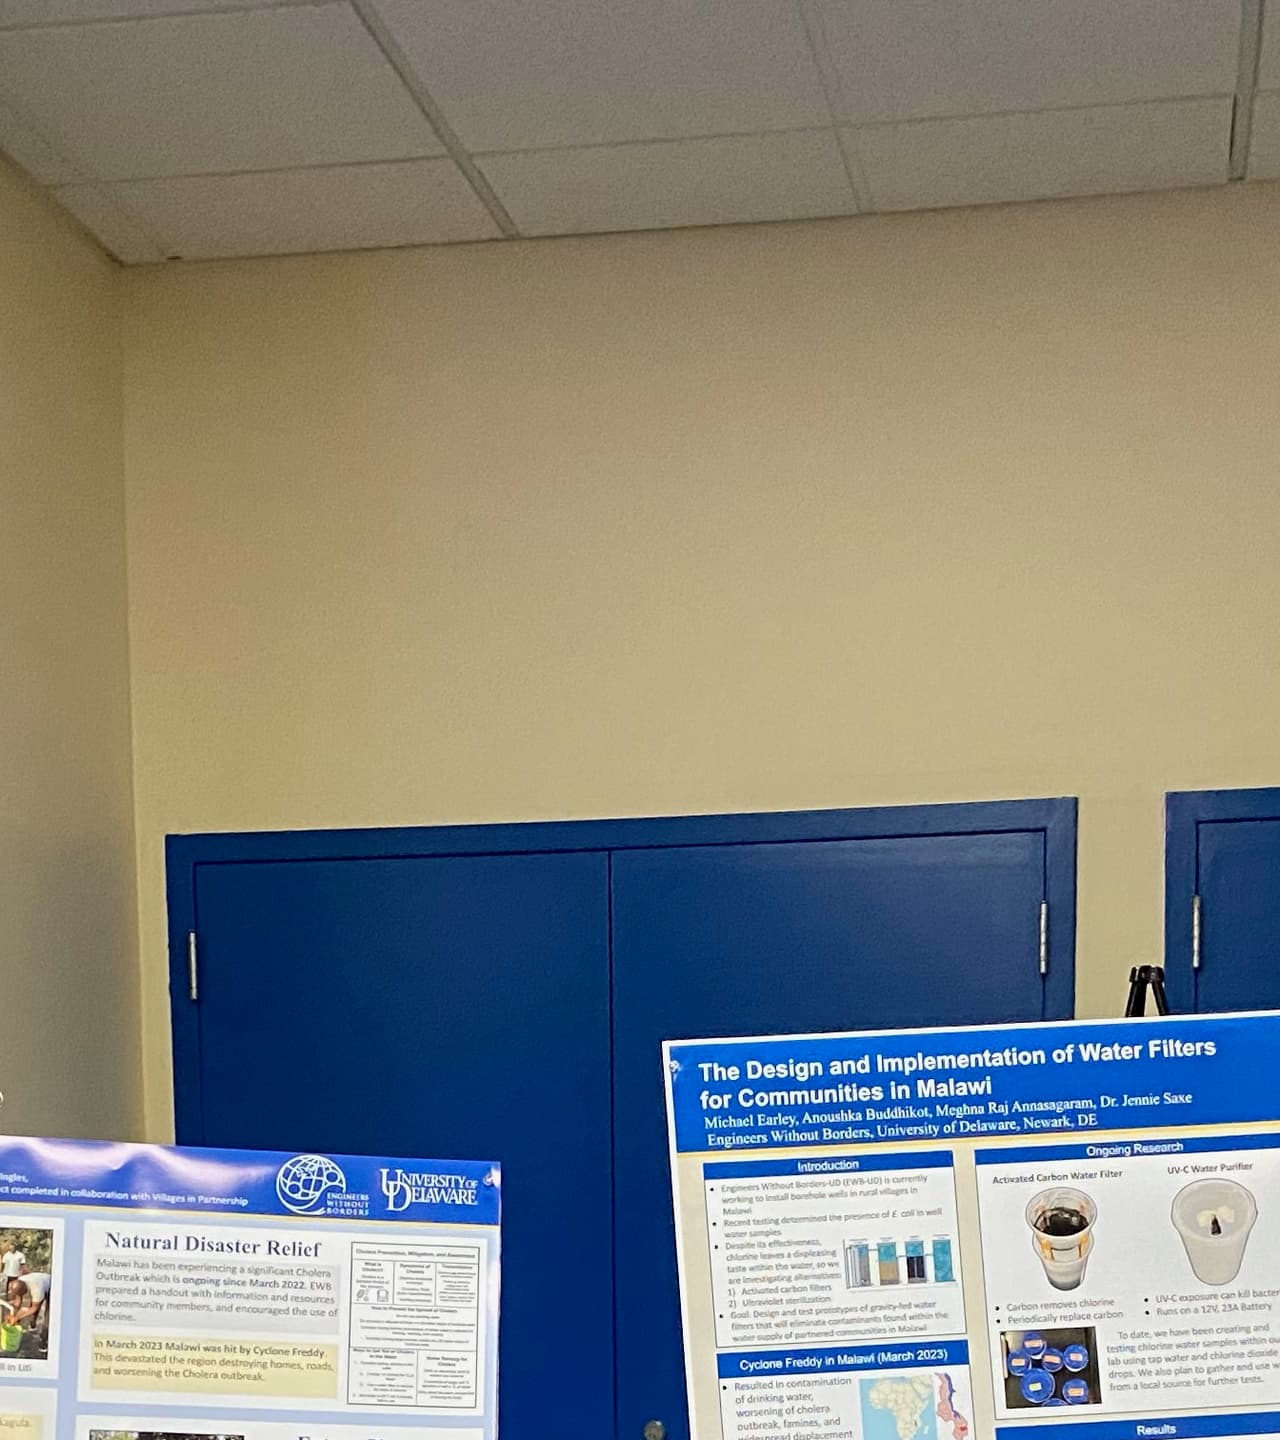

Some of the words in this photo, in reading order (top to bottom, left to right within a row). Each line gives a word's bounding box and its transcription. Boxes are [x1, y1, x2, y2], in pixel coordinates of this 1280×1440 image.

[698, 1061, 739, 1082] The
[746, 1057, 822, 1082] Design
[829, 1054, 870, 1075] and
[877, 1046, 1045, 1076] Implementation
[1052, 1045, 1074, 1063] of
[1078, 1042, 1142, 1062] Water
[1148, 1038, 1216, 1058] Filters
[699, 1089, 732, 1110] for
[738, 1081, 883, 1107] Communities
[890, 1080, 910, 1099] in
[917, 1076, 991, 1098] Malawi
[704, 1113, 753, 1129] Michael
[757, 1111, 799, 1129] Earley,
[802, 1108, 862, 1125] Anoushka
[866, 1104, 932, 1121] Buddhikot,
[936, 1102, 984, 1119] Meghna
[988, 1100, 1008, 1116] Raj
[1011, 1097, 1096, 1115] Annasagaram,
[1100, 1095, 1118, 1107] Dr.
[1122, 1093, 1160, 1106] Jennie
[1163, 1091, 1192, 1104] Saxe
[707, 1130, 768, 1149] Engineers
[770, 1128, 819, 1143] Without
[822, 1125, 874, 1141] Borders,
[877, 1121, 941, 1139] University
[943, 1120, 957, 1133] of
[959, 1118, 1022, 1133] Delaware,
[1023, 1117, 1075, 1130] Newark,
[1077, 1113, 1098, 1126] DE
[1086, 1145, 1131, 1157] Ongoing
[1133, 1141, 1184, 1154] Research
[797, 1159, 860, 1171] Introduction
[1167, 1165, 1188, 1174] UV-C
[1190, 1164, 1217, 1173] Water
[1220, 1162, 1252, 1171] Purifier
[380, 1168, 467, 1196] UNIVERSITY
[466, 1179, 479, 1189] OF
[992, 1173, 1034, 1184] Activated
[1036, 1172, 1068, 1181] Carbon
[1070, 1171, 1097, 1179] Water
[1100, 1169, 1122, 1178] Filter
[326, 1200, 368, 1208] WITHOUT
[385, 1181, 479, 1211] DELAWARE
[106, 1232, 177, 1250] Natural
[186, 1236, 260, 1253] Disaster
[267, 1240, 321, 1256] Relief
[1006, 1301, 1038, 1311] Carbon
[1040, 1301, 1077, 1309] removes
[1079, 1297, 1114, 1307] chlorine
[1155, 1293, 1177, 1304] UV-C
[1178, 1293, 1218, 1302] exposure
[1220, 1291, 1236, 1300] can
[1237, 1289, 1250, 1298] kill
[1156, 1306, 1178, 1316] Runs
[1221, 1303, 1239, 1312] 23A
[1240, 1301, 1272, 1312] Battery
[1007, 1313, 1057, 1325] Periodically
[1059, 1311, 1092, 1322] replace
[1093, 1310, 1123, 1319] carbon
[106, 1340, 136, 1349] March
[139, 1342, 162, 1350] 2023
[165, 1342, 200, 1351] Malawi
[224, 1345, 237, 1353] hit
[239, 1345, 251, 1355] by
[253, 1346, 290, 1357] Cyclone
[92, 1353, 112, 1361] This
[114, 1354, 167, 1367] devastated
[168, 1356, 186, 1368] the
[186, 1356, 216, 1369] region
[218, 1357, 268, 1370] destroying
[739, 1357, 782, 1373] Cyclone
[785, 1355, 822, 1370] Freddy
[825, 1355, 834, 1365] in
[837, 1353, 874, 1364] Malawi
[877, 1350, 914, 1364] (March
[916, 1348, 947, 1362] 2023)
[93, 1366, 111, 1375] and
[113, 1367, 162, 1378] worsening
[164, 1369, 180, 1377] the
[182, 1369, 218, 1381] Cholera
[1136, 1423, 1176, 1435] Results
